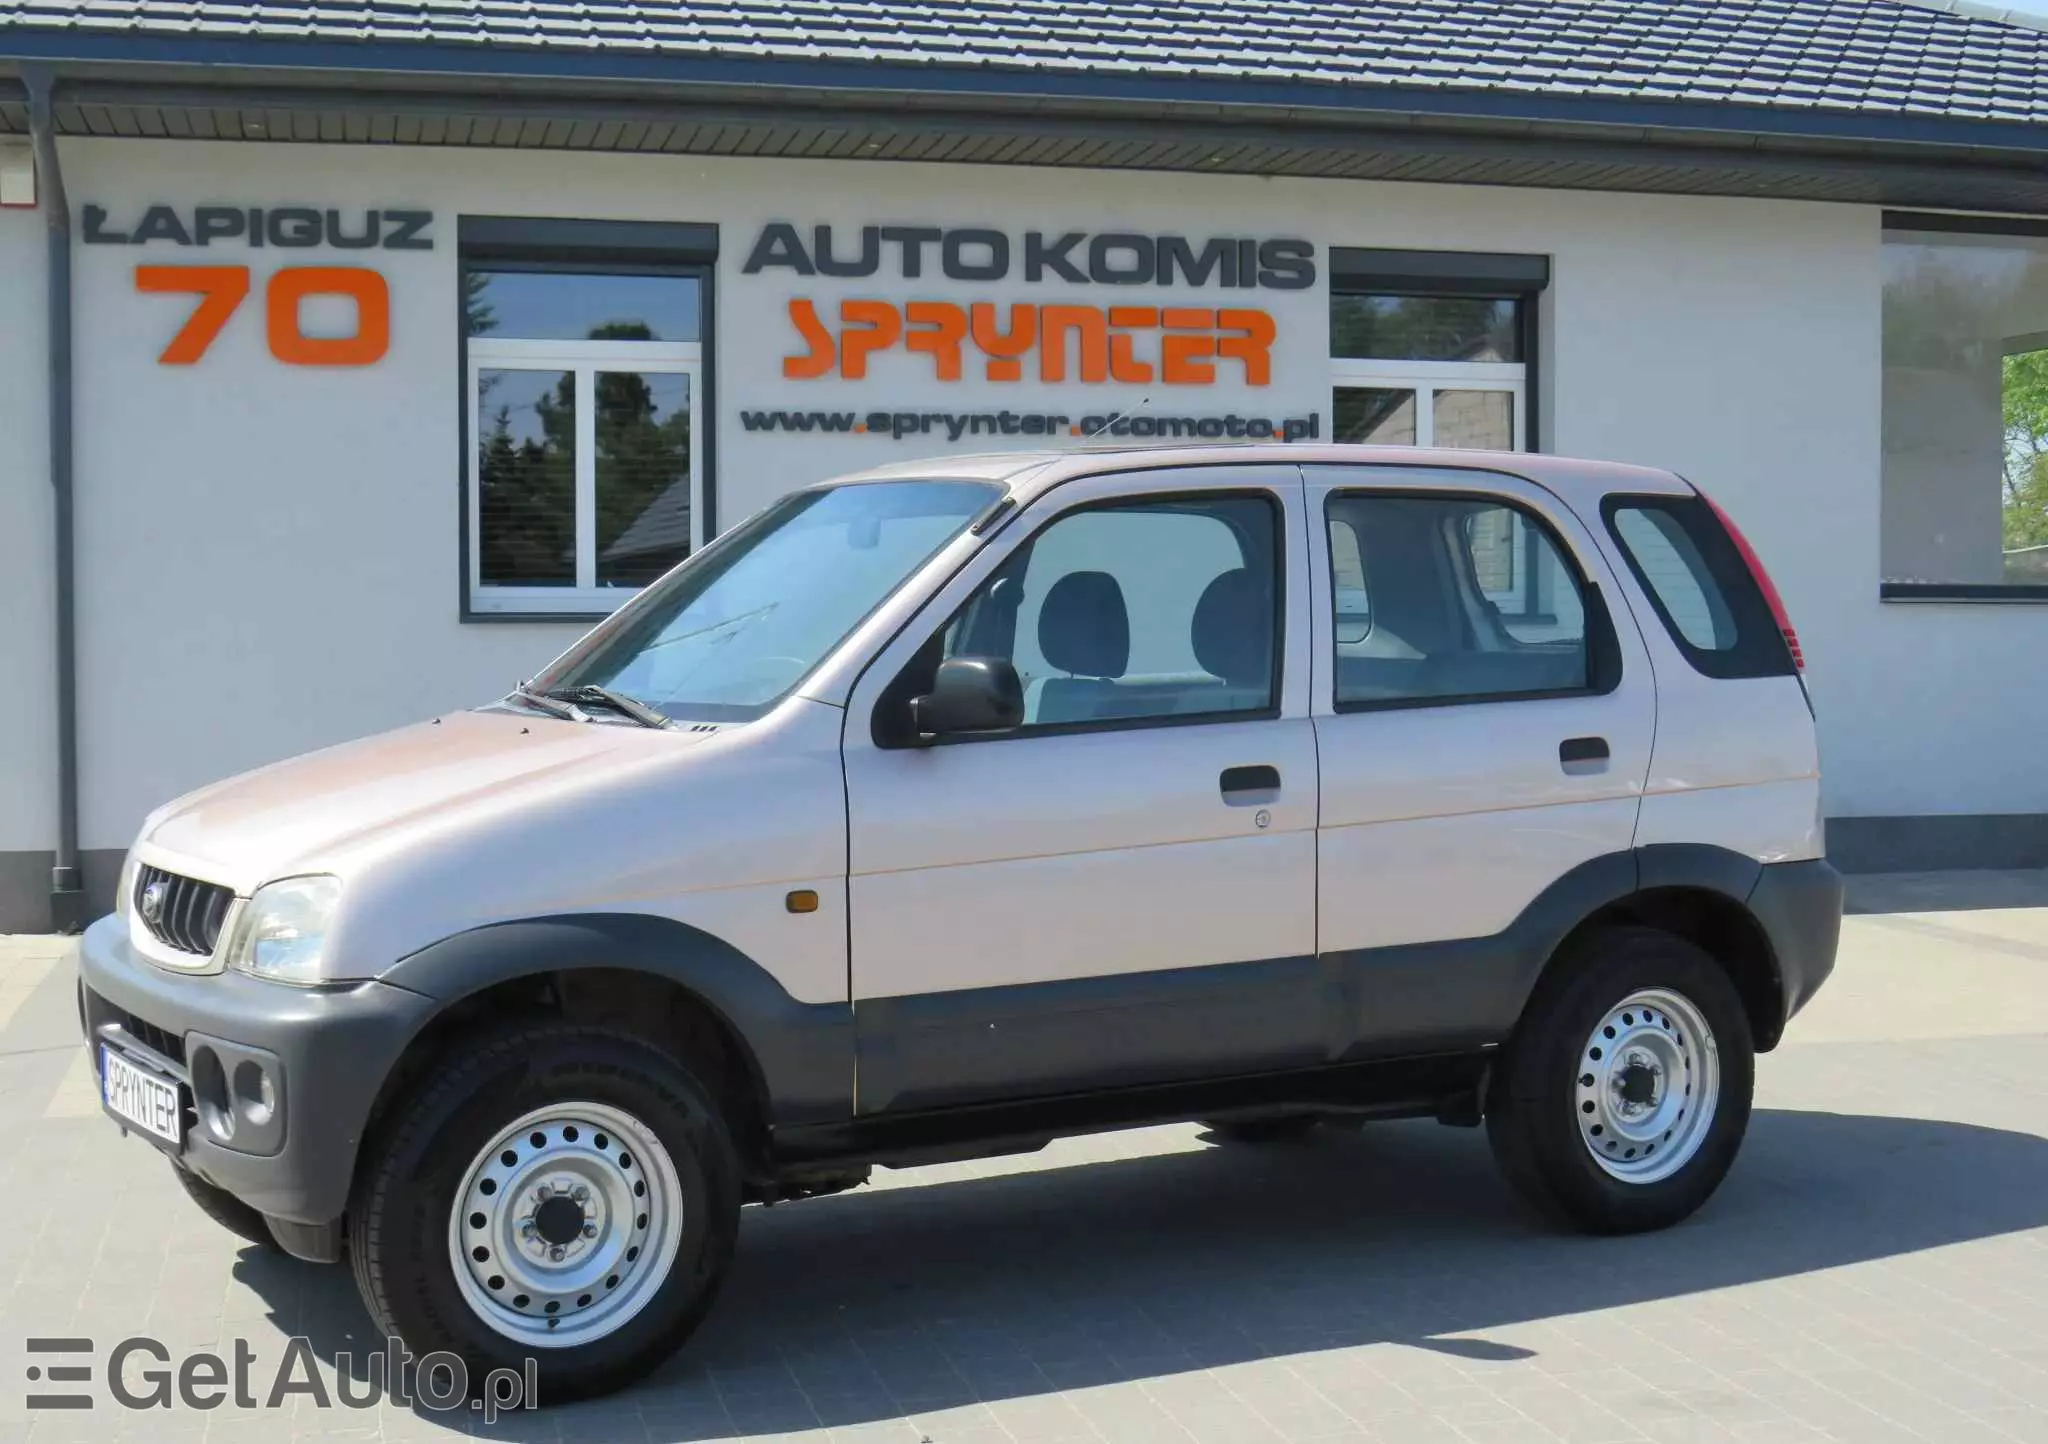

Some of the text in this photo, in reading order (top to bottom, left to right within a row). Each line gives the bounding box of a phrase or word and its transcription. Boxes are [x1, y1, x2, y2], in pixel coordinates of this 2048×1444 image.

[83, 205, 433, 249] ŁAPIGUZ
[742, 224, 1315, 289] AUTO KOMIS
[134, 265, 389, 366] 70
[783, 299, 1276, 385] SPRYNTER
[740, 410, 1319, 441] www.sprynter.otomoto.pl
[109, 1057, 177, 1138] SPRYNTER
